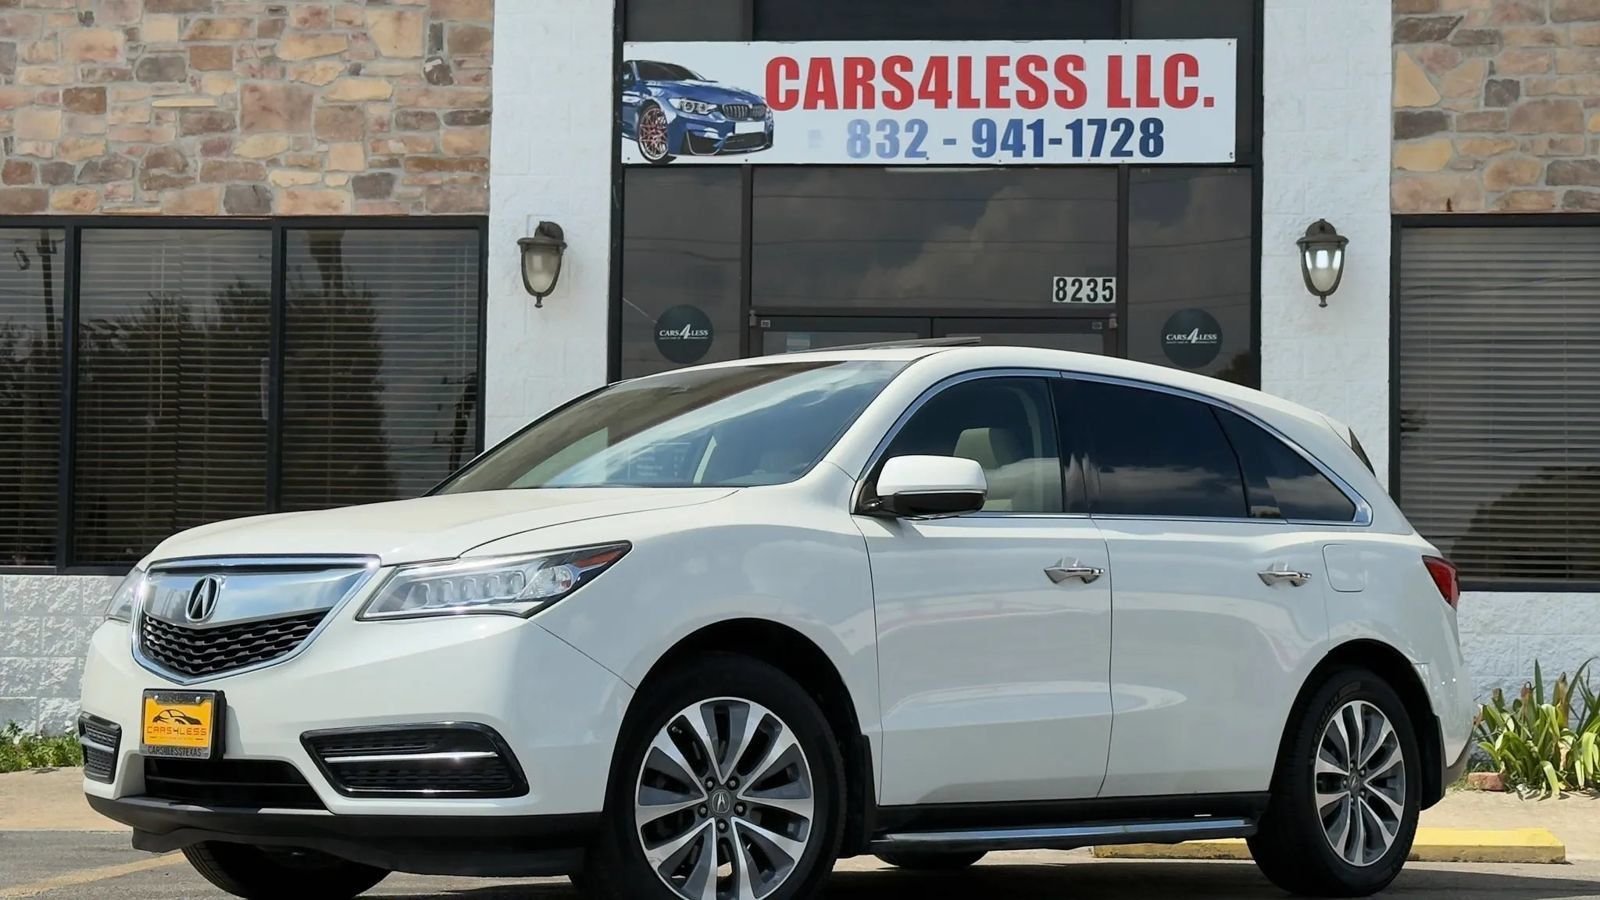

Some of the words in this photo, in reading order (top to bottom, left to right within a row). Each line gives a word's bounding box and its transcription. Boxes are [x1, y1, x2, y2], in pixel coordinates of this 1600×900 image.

[765, 54, 1088, 111] CARS4LESS
[1107, 53, 1215, 109] LLC.
[847, 118, 929, 159] 832
[972, 117, 1164, 159] 941-1728
[1055, 277, 1114, 302] 8235
